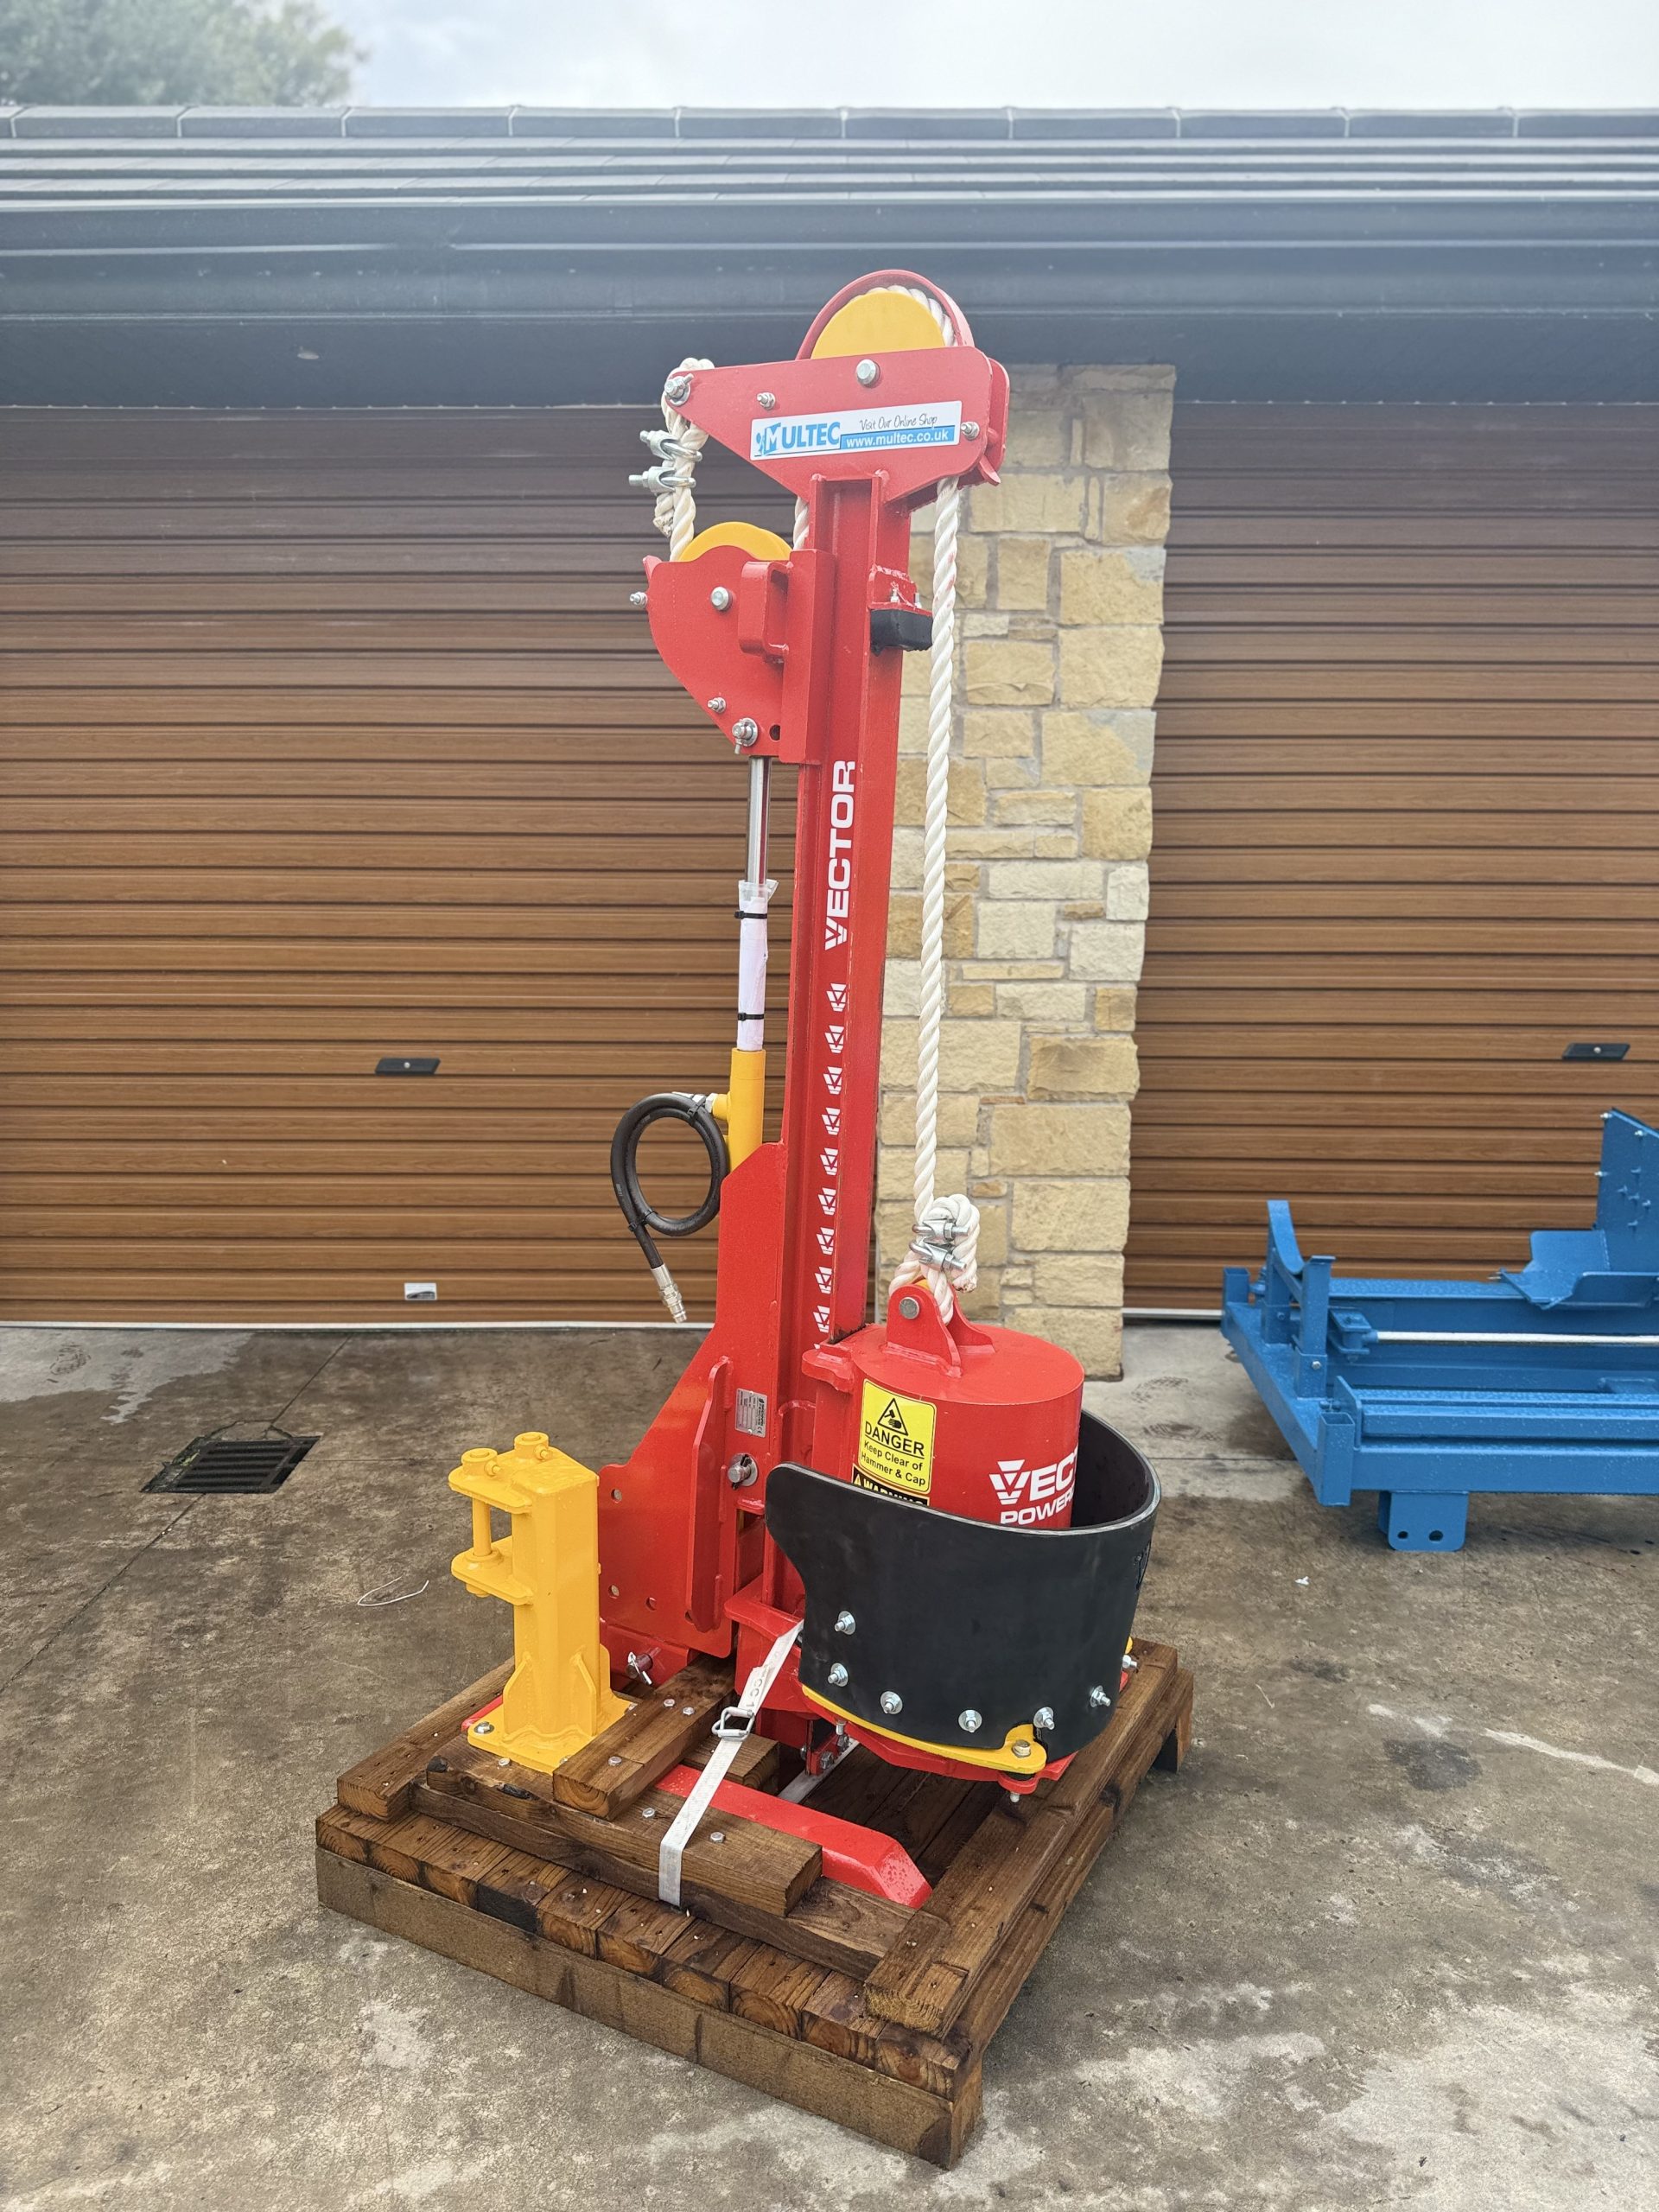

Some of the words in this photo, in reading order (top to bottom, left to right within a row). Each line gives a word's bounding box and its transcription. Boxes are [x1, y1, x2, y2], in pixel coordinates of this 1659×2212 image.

[860, 420, 876, 430] Visit
[879, 416, 891, 429] Our
[894, 415, 917, 428] Online
[919, 413, 938, 427] Shop
[764, 422, 841, 454] MULTEC
[846, 429, 949, 448] www.multec.co.uk
[825, 760, 855, 950] VECTOR
[865, 1421, 925, 1457] DANGER
[861, 1452, 893, 1475] Hammer
[895, 1469, 902, 1479] &
[905, 1472, 926, 1487] Cap
[864, 1440, 882, 1458] Keep
[885, 1451, 909, 1467] Clear
[912, 1462, 923, 1471] of
